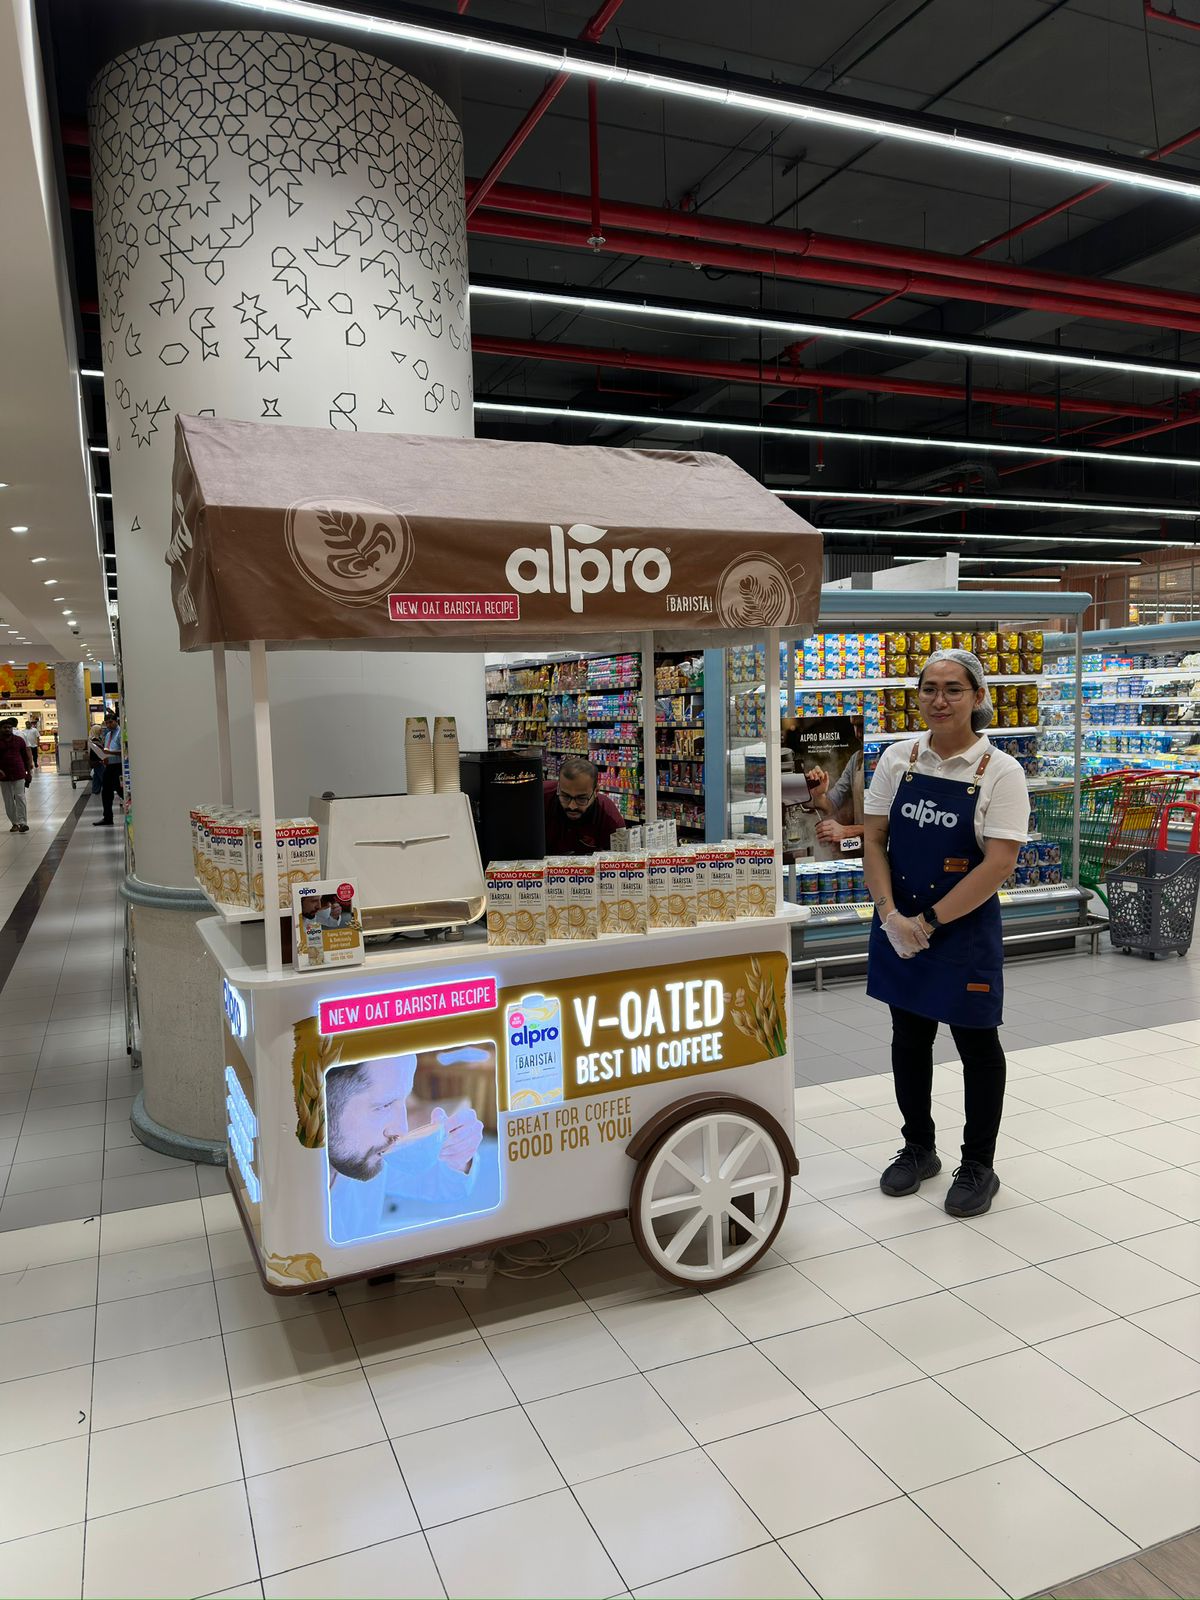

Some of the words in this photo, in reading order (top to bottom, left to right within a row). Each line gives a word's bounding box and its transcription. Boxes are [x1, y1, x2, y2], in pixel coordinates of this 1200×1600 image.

[505, 525, 672, 612] alpro
[396, 601, 419, 614] NEW
[422, 601, 443, 615] OAT
[443, 601, 482, 614] BARISTA
[484, 601, 514, 614] RECIPE
[670, 596, 710, 612] BARISTA
[800, 733, 818, 742] ALPRO
[819, 732, 840, 741] BARISTA
[901, 799, 958, 828] alpro
[288, 837, 317, 848] alpro
[842, 840, 859, 850] alpro
[709, 860, 734, 870] alpro
[749, 856, 773, 866] alpro
[600, 871, 616, 880] pro
[619, 869, 644, 880] alpro
[648, 865, 666, 875] lpro
[670, 864, 694, 875] alpro
[487, 879, 513, 890] alpro
[517, 879, 542, 890] alpro
[547, 874, 565, 885] lpro
[568, 874, 594, 885] alpro
[298, 888, 316, 896] alpro
[520, 892, 539, 900] BARISTA
[328, 1006, 359, 1027] NEW
[365, 1001, 390, 1021] OAT
[395, 993, 446, 1016] BARISTA
[451, 986, 490, 1008] RECIPE
[573, 980, 725, 1047] V-OATED
[511, 1025, 559, 1048] alpro
[519, 1051, 553, 1069] BARISTA
[576, 1049, 624, 1085] BEST
[630, 1043, 651, 1075] IN
[656, 1031, 724, 1070] COFFEE
[507, 1112, 549, 1137] GREAT
[555, 1107, 579, 1128] FOR
[585, 1096, 631, 1121] COFFEE
[508, 1133, 553, 1162] GOOD
[561, 1125, 589, 1151] FOR
[597, 1117, 632, 1143] YOU!
